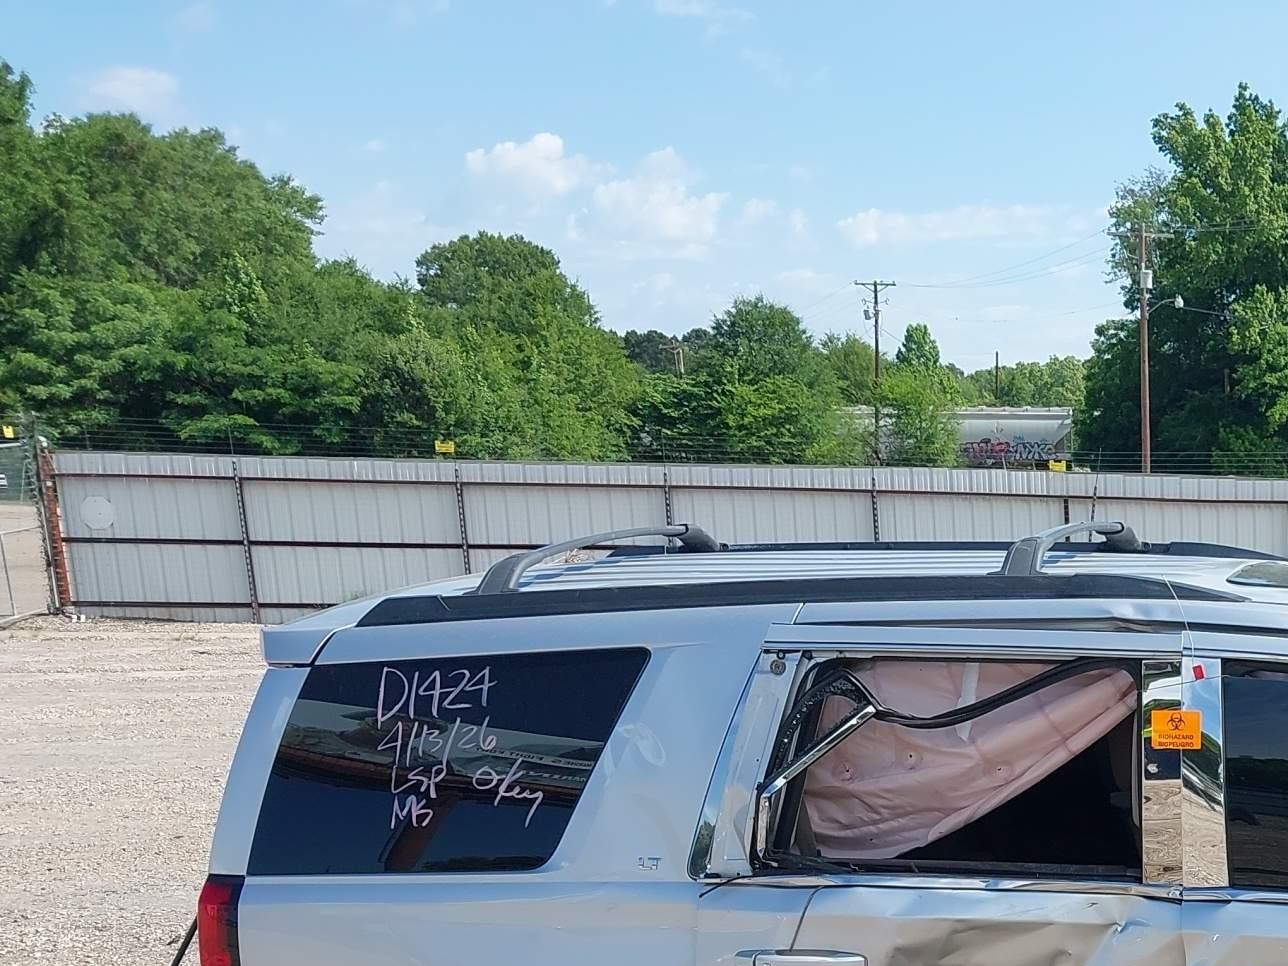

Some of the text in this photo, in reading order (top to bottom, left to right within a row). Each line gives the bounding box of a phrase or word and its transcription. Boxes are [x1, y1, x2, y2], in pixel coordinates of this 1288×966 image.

[377, 667, 498, 729] D1424
[377, 716, 497, 768] 4/13/26
[638, 856, 662, 870] LT
